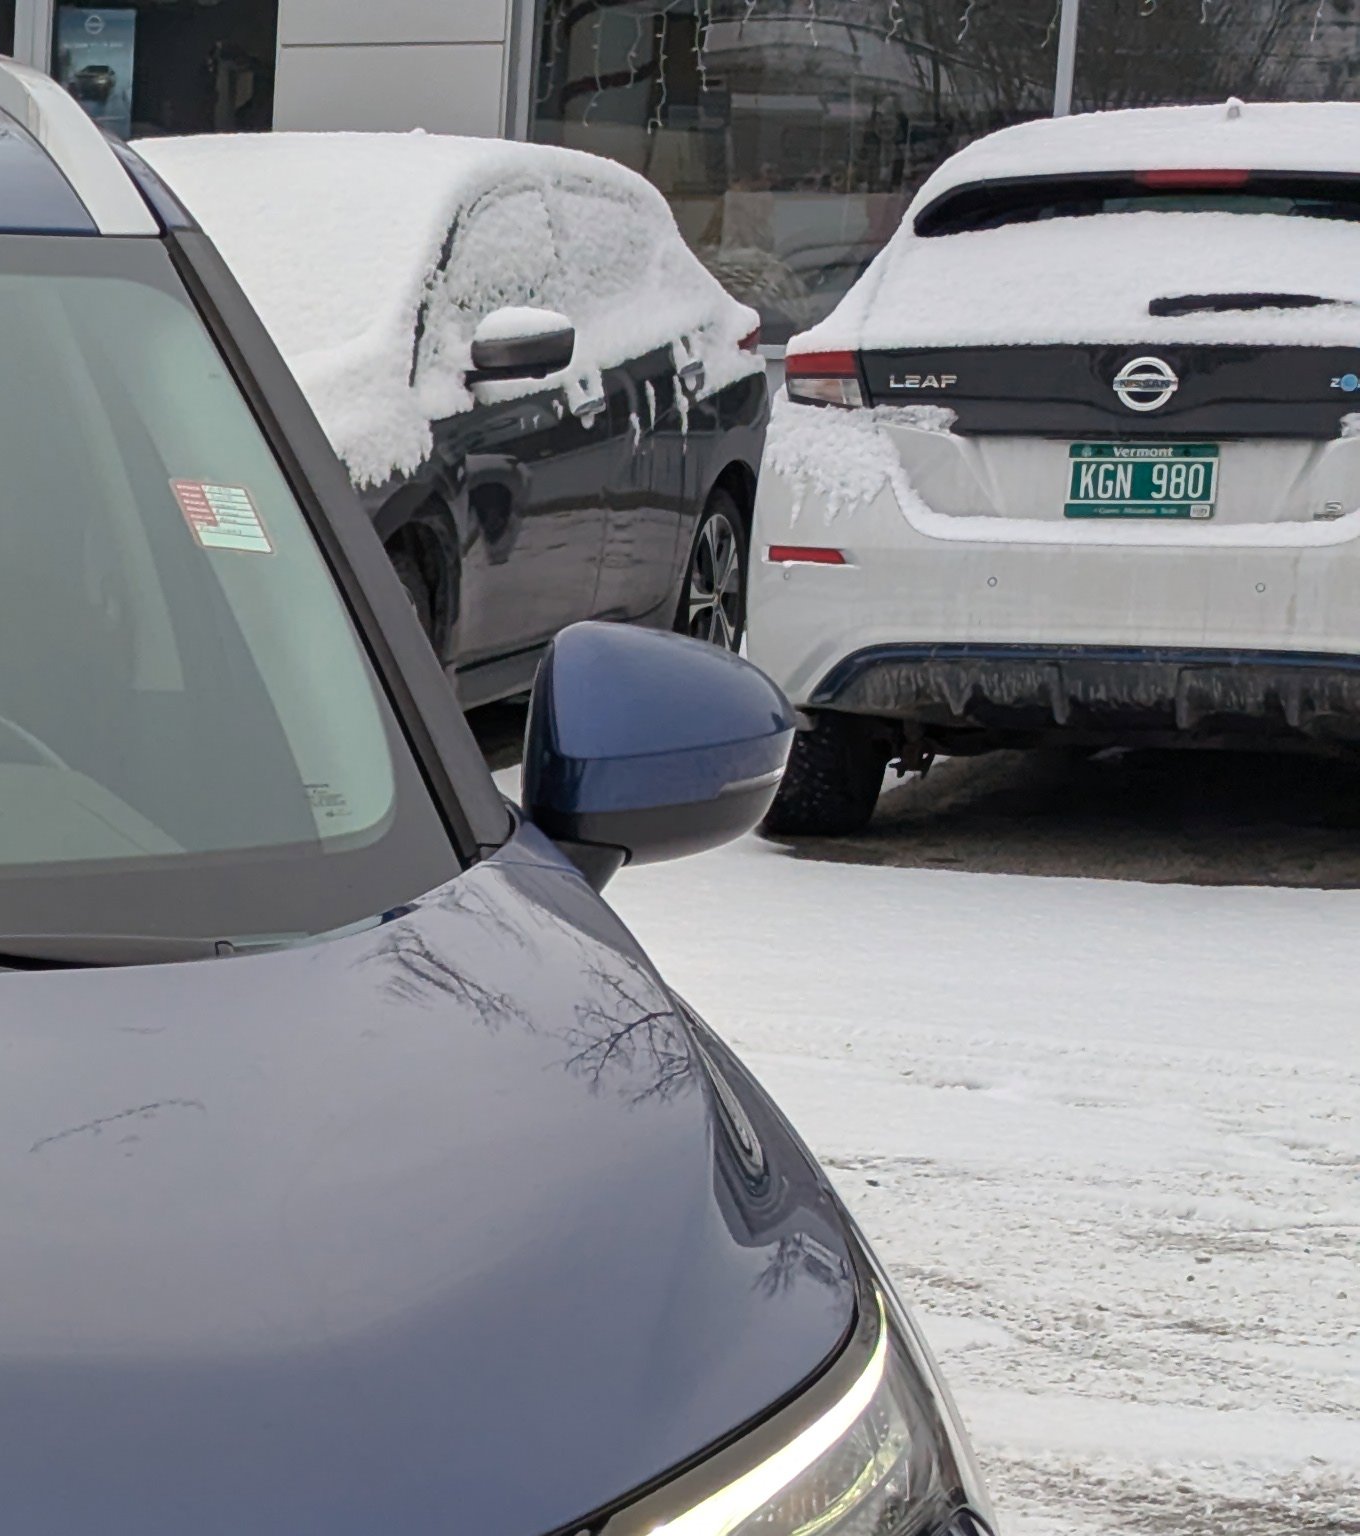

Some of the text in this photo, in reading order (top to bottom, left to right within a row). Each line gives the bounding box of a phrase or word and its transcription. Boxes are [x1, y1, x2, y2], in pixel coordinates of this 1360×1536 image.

[889, 375, 958, 388] LEAF
[1113, 447, 1174, 458] Vermont
[1080, 463, 1205, 499] KGN 980
